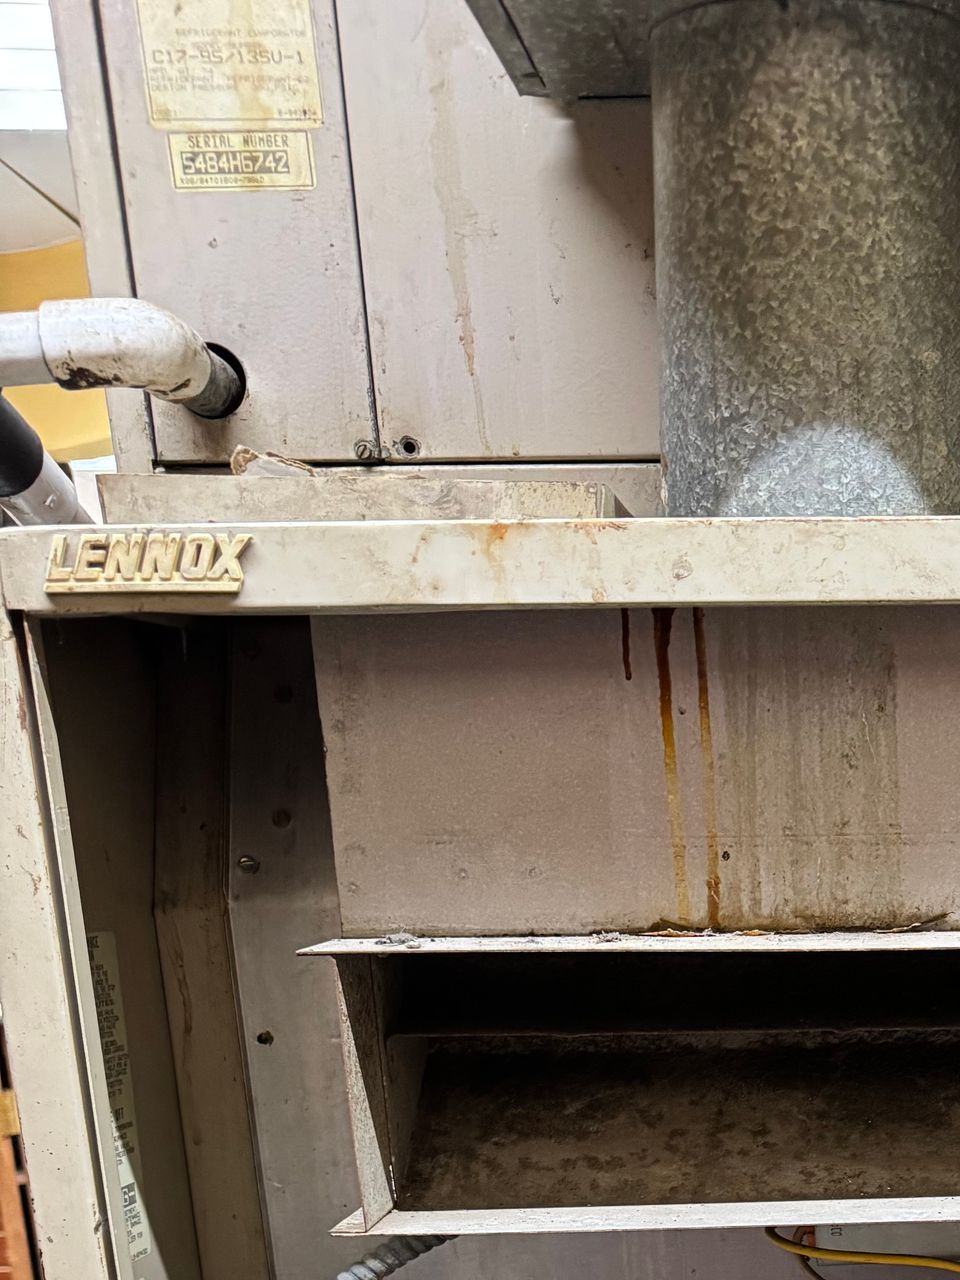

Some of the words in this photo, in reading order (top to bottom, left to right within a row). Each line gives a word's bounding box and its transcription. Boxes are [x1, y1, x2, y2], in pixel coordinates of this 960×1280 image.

[187, 134, 234, 149] SERIAL
[242, 134, 290, 148] NUMBER
[46, 533, 253, 582] LENNOX
